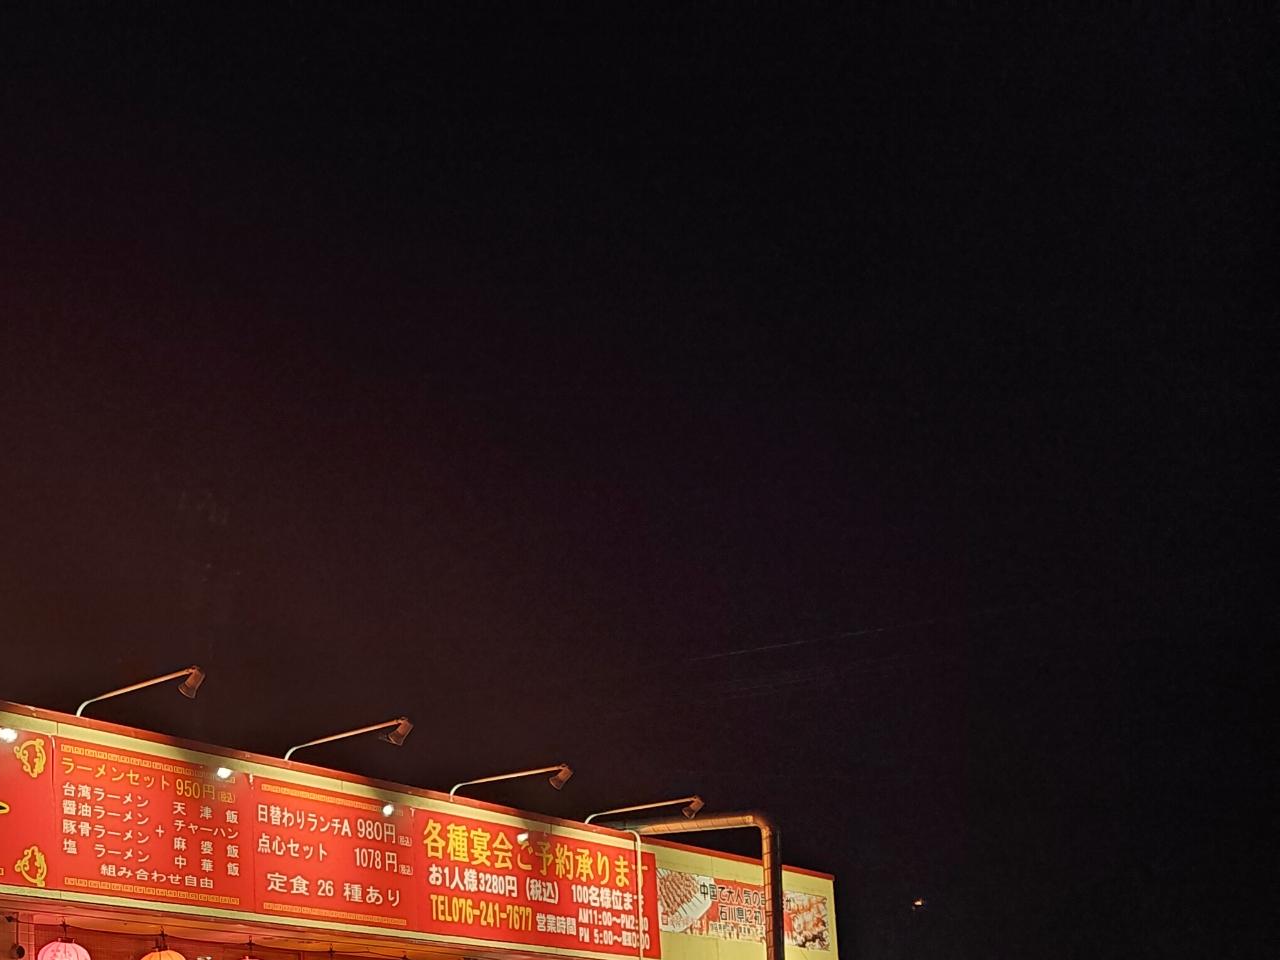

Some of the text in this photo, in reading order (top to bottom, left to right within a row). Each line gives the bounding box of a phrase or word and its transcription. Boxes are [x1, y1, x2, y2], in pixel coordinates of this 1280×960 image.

[61, 758, 170, 790] ラーメンセット
[62, 783, 149, 807] 台湾ラーメン
[62, 801, 149, 825] 醤油ラーメン
[62, 820, 150, 844] 豚骨ラーメン
[173, 820, 239, 840] チャーハン
[257, 833, 327, 862] 点心セット
[100, 864, 213, 889] 組み合わせ自由
[536, 914, 577, 936] 営業時間
[578, 908, 649, 932] AM11:00～PM2:0
[719, 904, 765, 926] 石川県に初
